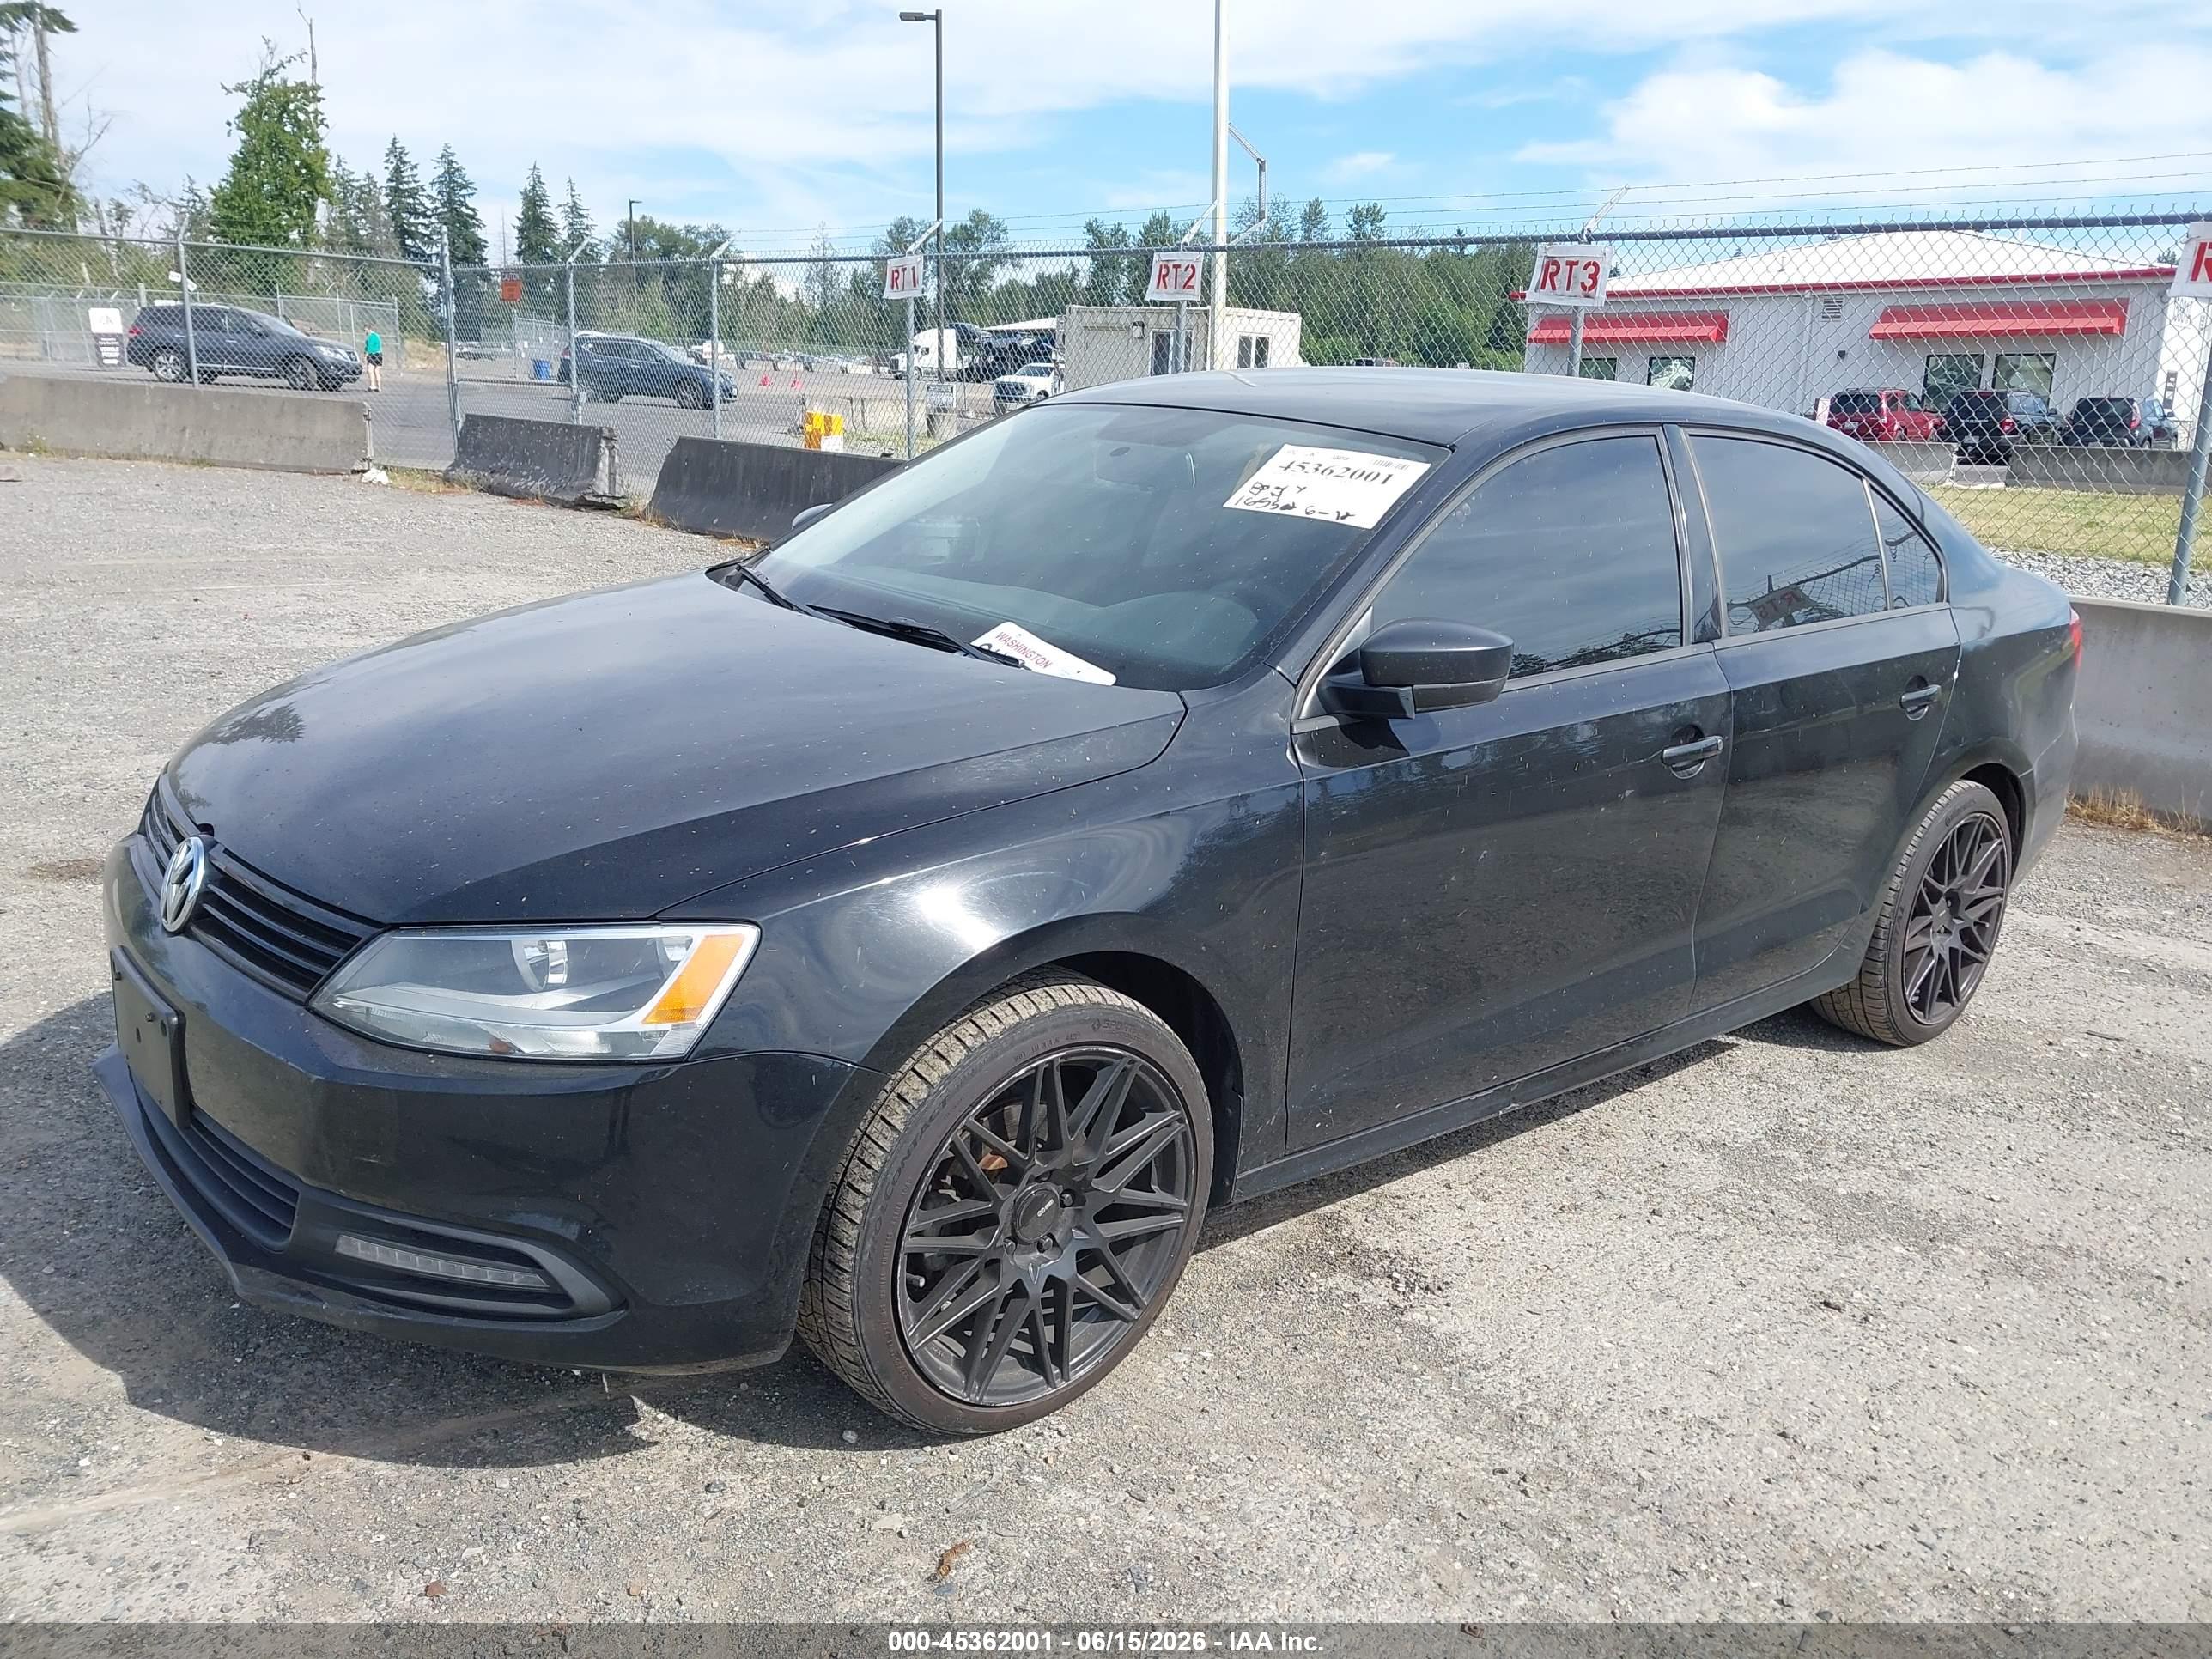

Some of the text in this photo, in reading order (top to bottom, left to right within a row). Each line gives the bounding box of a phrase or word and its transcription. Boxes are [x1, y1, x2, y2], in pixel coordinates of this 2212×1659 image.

[1155, 264, 1197, 290] RT2
[1540, 259, 1601, 293] RT3
[1279, 460, 1394, 485] 45362001
[994, 631, 1054, 669] WASHINGTON
